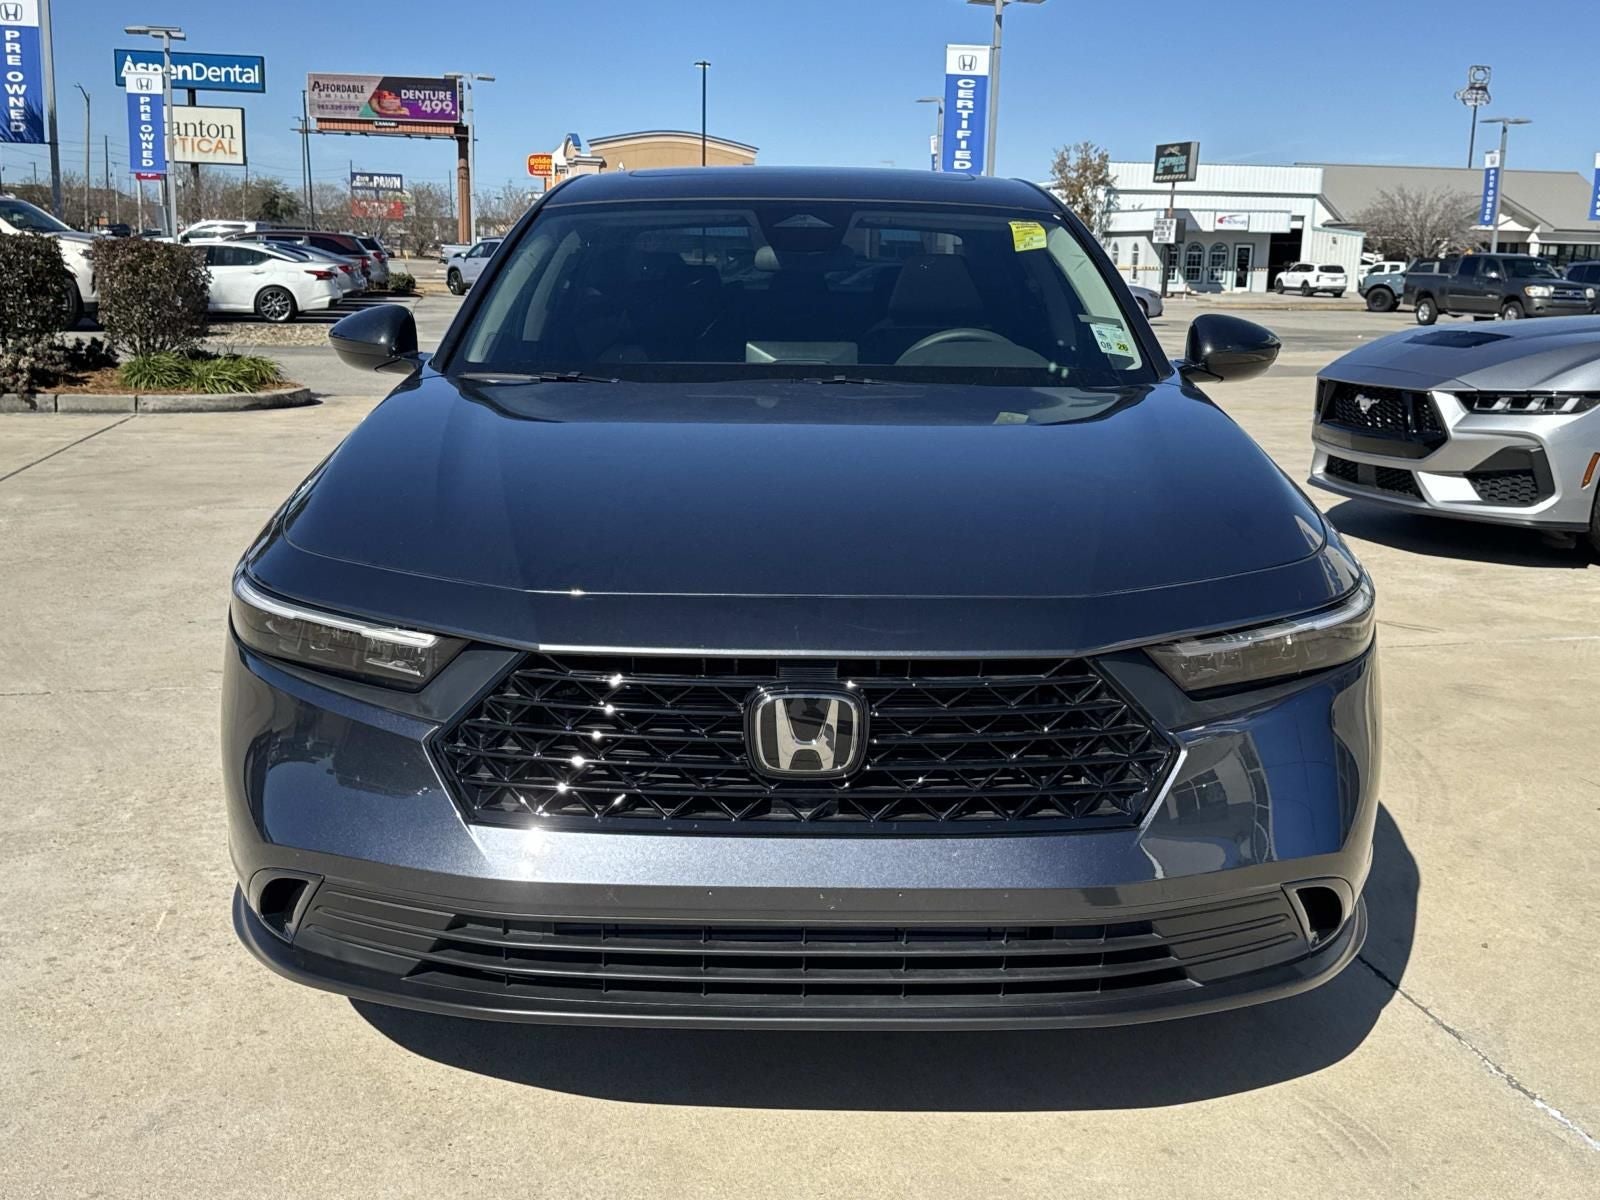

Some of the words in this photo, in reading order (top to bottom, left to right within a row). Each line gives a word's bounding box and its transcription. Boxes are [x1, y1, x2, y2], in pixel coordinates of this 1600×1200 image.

[5, 30, 22, 66] PRE
[5, 71, 26, 133] OWNED
[312, 80, 365, 94] AFFORDABLE
[400, 89, 452, 101] DENTURE
[140, 96, 152, 122] PRE
[953, 78, 976, 170] CERTIFIED
[139, 124, 154, 167] OWNED
[373, 175, 401, 189] PAWN
